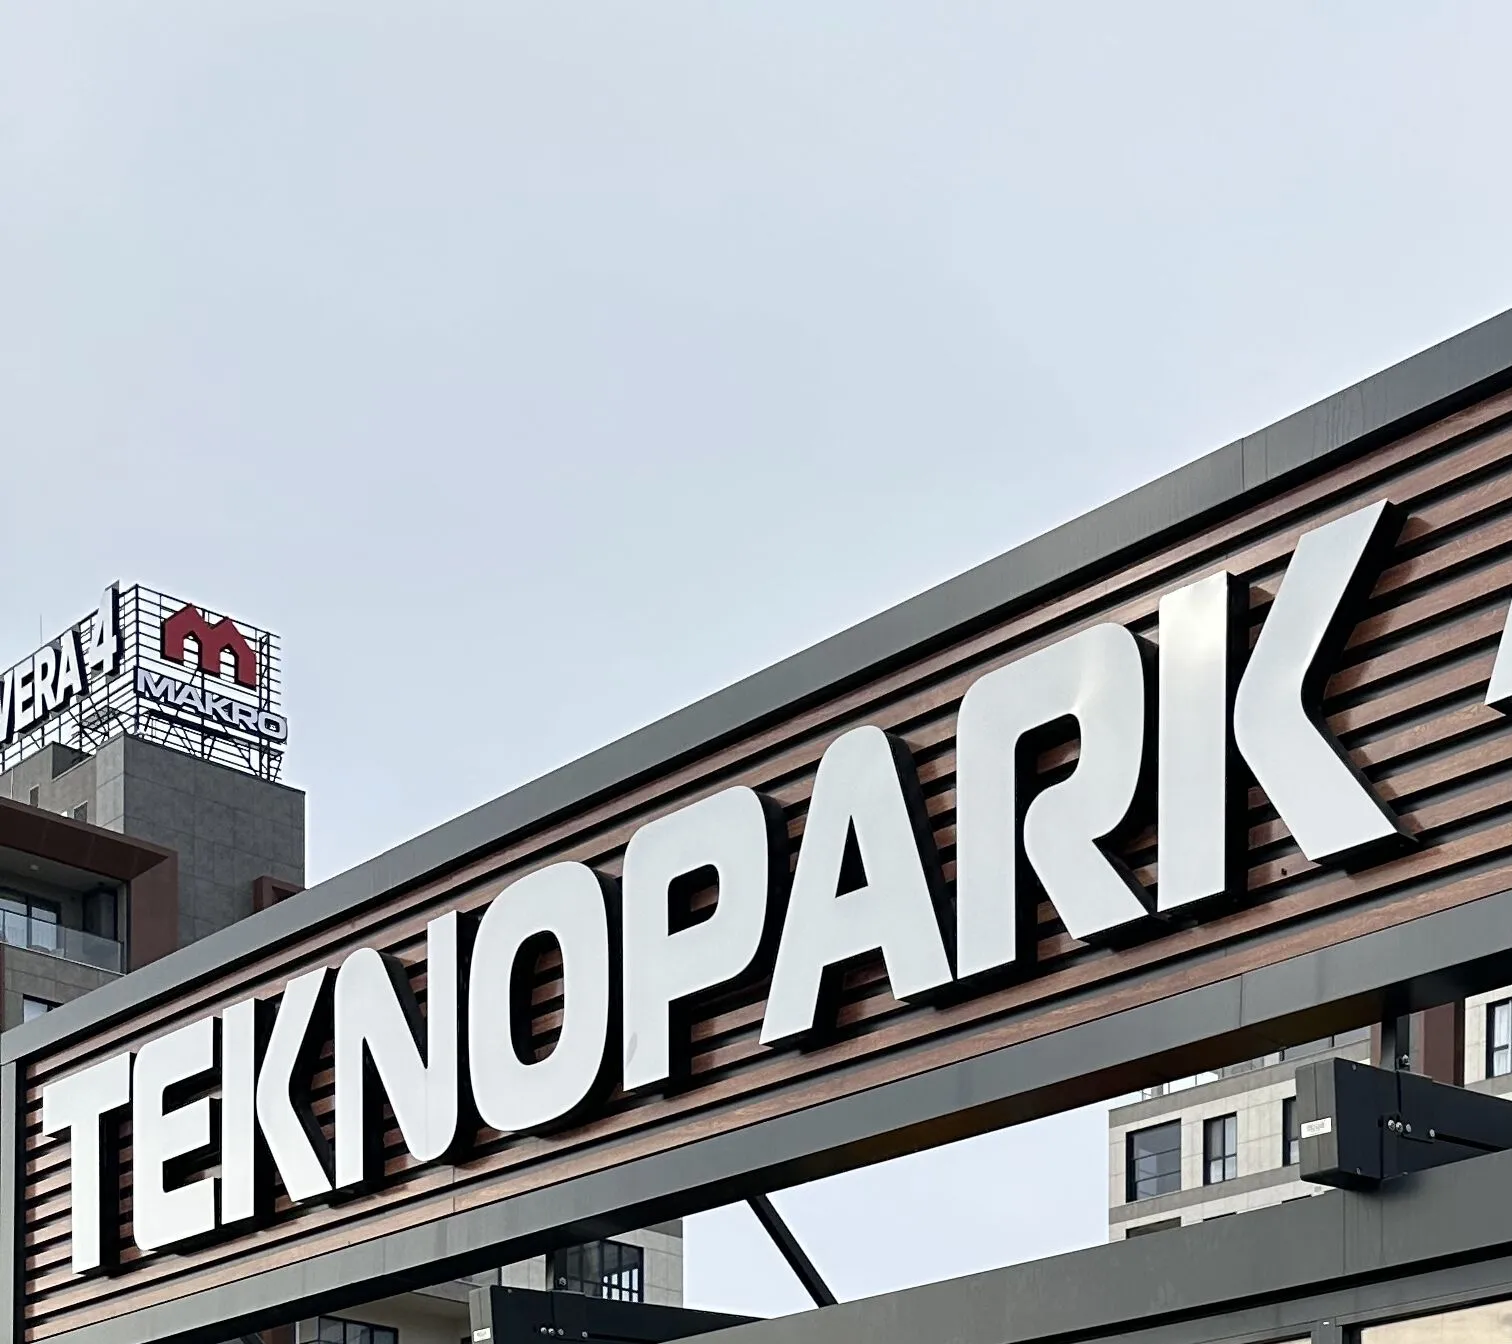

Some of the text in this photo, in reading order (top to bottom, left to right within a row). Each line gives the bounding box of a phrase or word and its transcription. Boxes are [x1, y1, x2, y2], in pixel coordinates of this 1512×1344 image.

[88, 582, 119, 675] 4
[136, 666, 288, 742] MAKRO
[42, 500, 1400, 1273] TEKNOPARK
